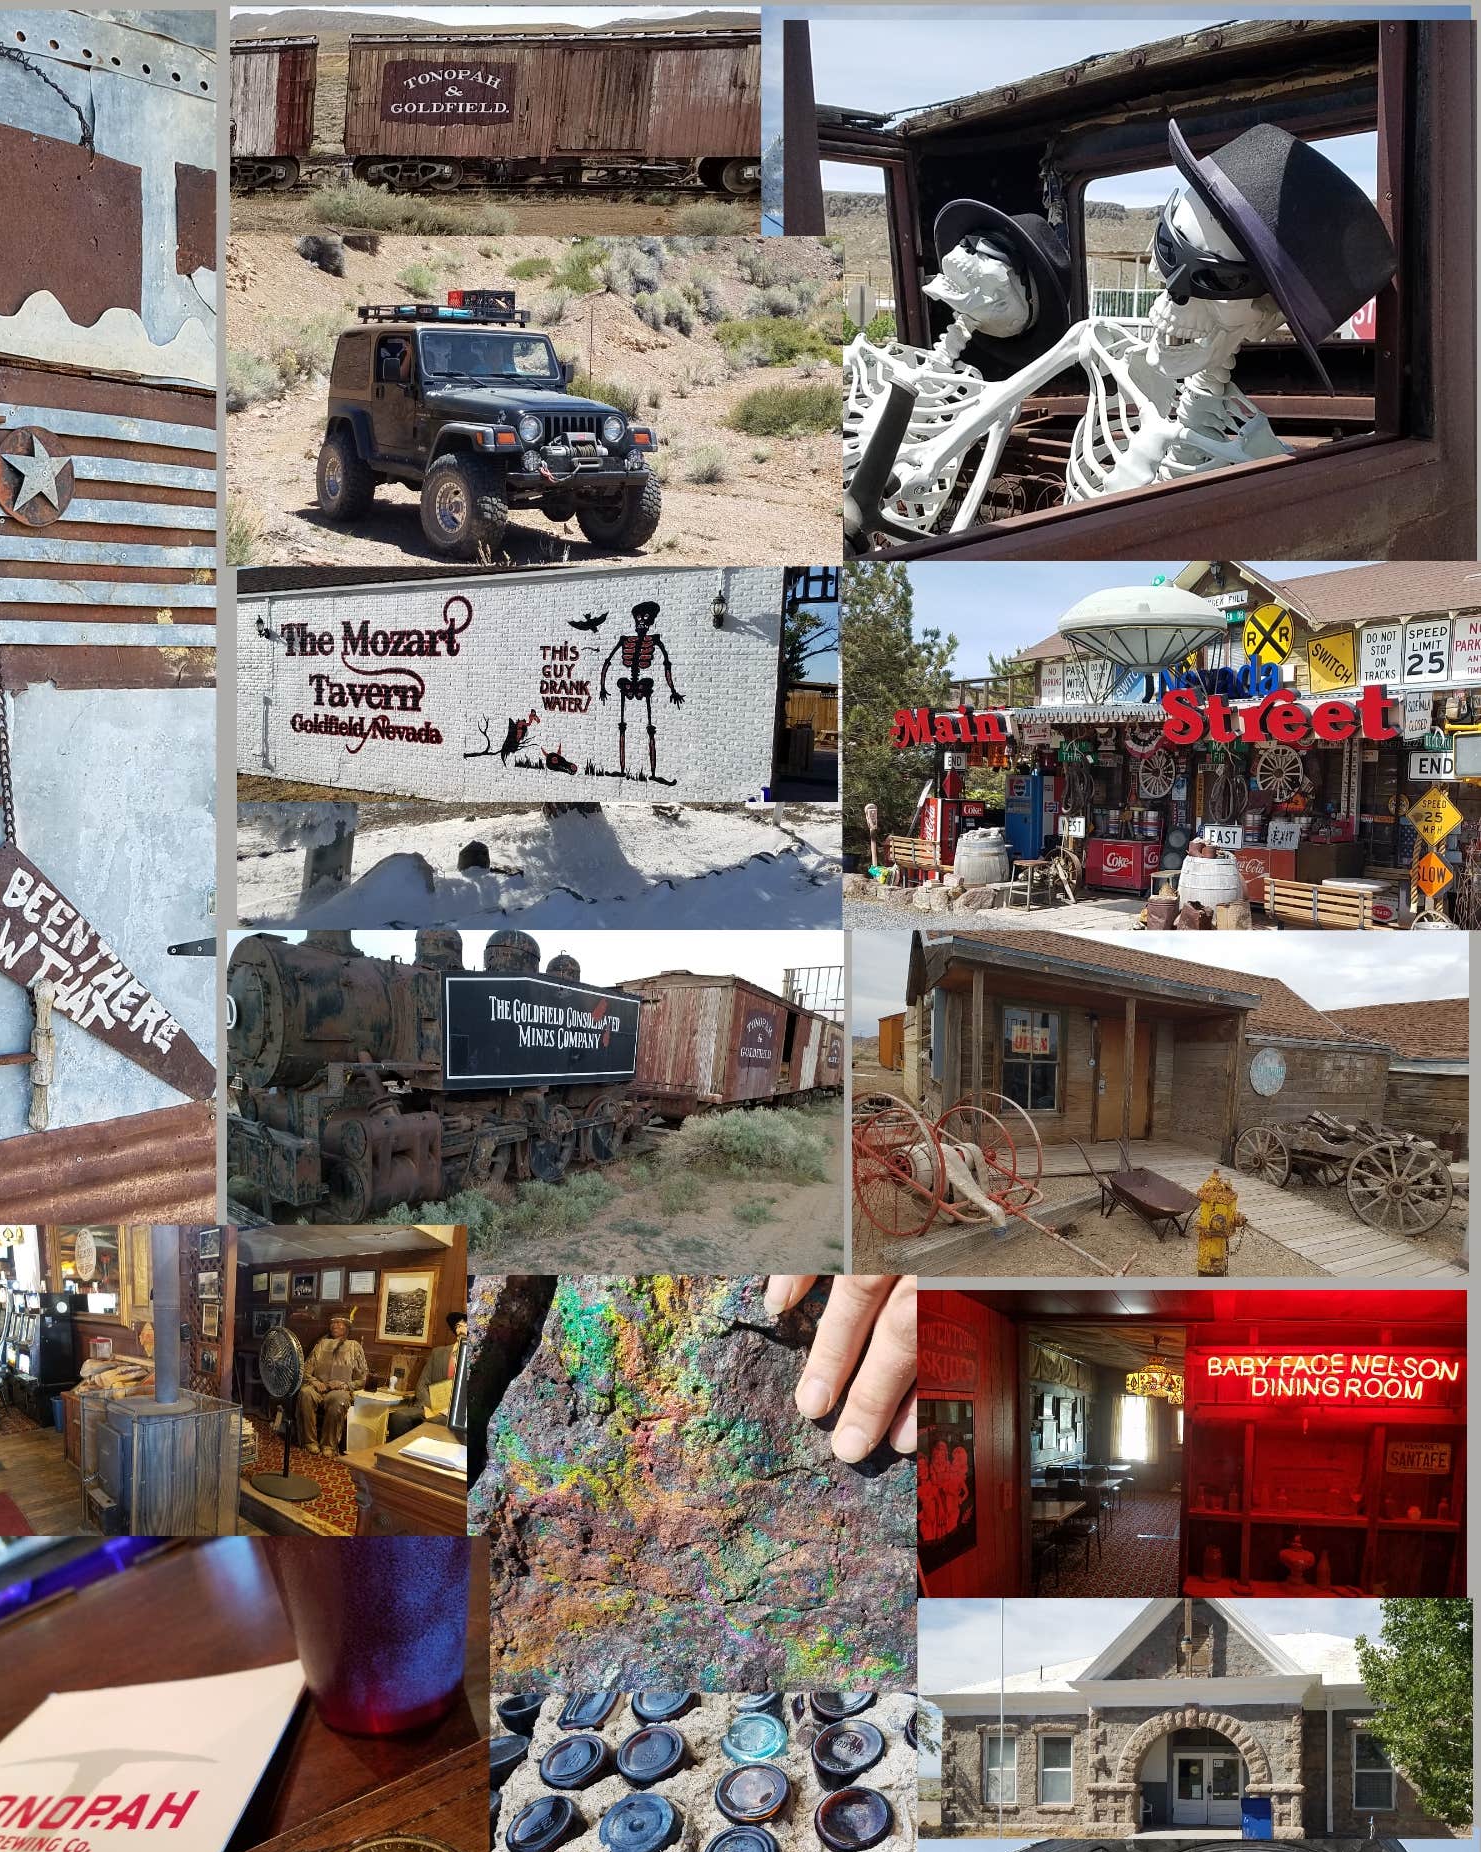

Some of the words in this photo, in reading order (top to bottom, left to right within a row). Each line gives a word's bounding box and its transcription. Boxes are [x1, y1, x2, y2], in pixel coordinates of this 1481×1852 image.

[403, 69, 502, 92] TONOPAH
[445, 85, 464, 98] &
[281, 622, 334, 657] The
[341, 596, 474, 657] Mozart
[1408, 626, 1448, 640] SPEED
[1366, 633, 1379, 644] DO
[1381, 631, 1397, 642] NOT
[1412, 639, 1442, 652] LIMIT
[1371, 645, 1392, 656] STOP
[1311, 643, 1353, 685] SWITCH
[1375, 657, 1387, 668] ON
[1406, 651, 1445, 677] 25
[542, 663, 573, 680] GUY
[1364, 669, 1396, 681] TRACKS
[308, 674, 425, 712] Tavern
[540, 679, 590, 697] DRANK
[1163, 685, 1401, 745] Street
[365, 714, 443, 746] Nevada
[889, 705, 1007, 749] Main
[948, 757, 961, 766] END
[1419, 758, 1453, 774] END
[963, 805, 982, 815] Coke
[1422, 800, 1447, 809] SPEED
[1424, 812, 1443, 823] 25
[1210, 831, 1237, 845] EAST
[1273, 830, 1294, 843] EXIT
[1422, 826, 1442, 834] MPH
[1107, 853, 1129, 868] Coke
[2, 867, 91, 960] BEEN
[80, 930, 180, 1054] THERE
[34, 950, 117, 1031] THAT
[489, 996, 511, 1021] THE
[513, 1000, 564, 1025] GOLDFIELD
[518, 1026, 554, 1048] MINES
[556, 1027, 601, 1049] COMPANY
[1015, 1034, 1048, 1051] OPEN
[1207, 1356, 1273, 1377] BABY
[1280, 1354, 1345, 1376] FACE
[1350, 1353, 1460, 1382] NELSON
[1251, 1377, 1340, 1400] DINING
[1345, 1378, 1425, 1401] ROOM
